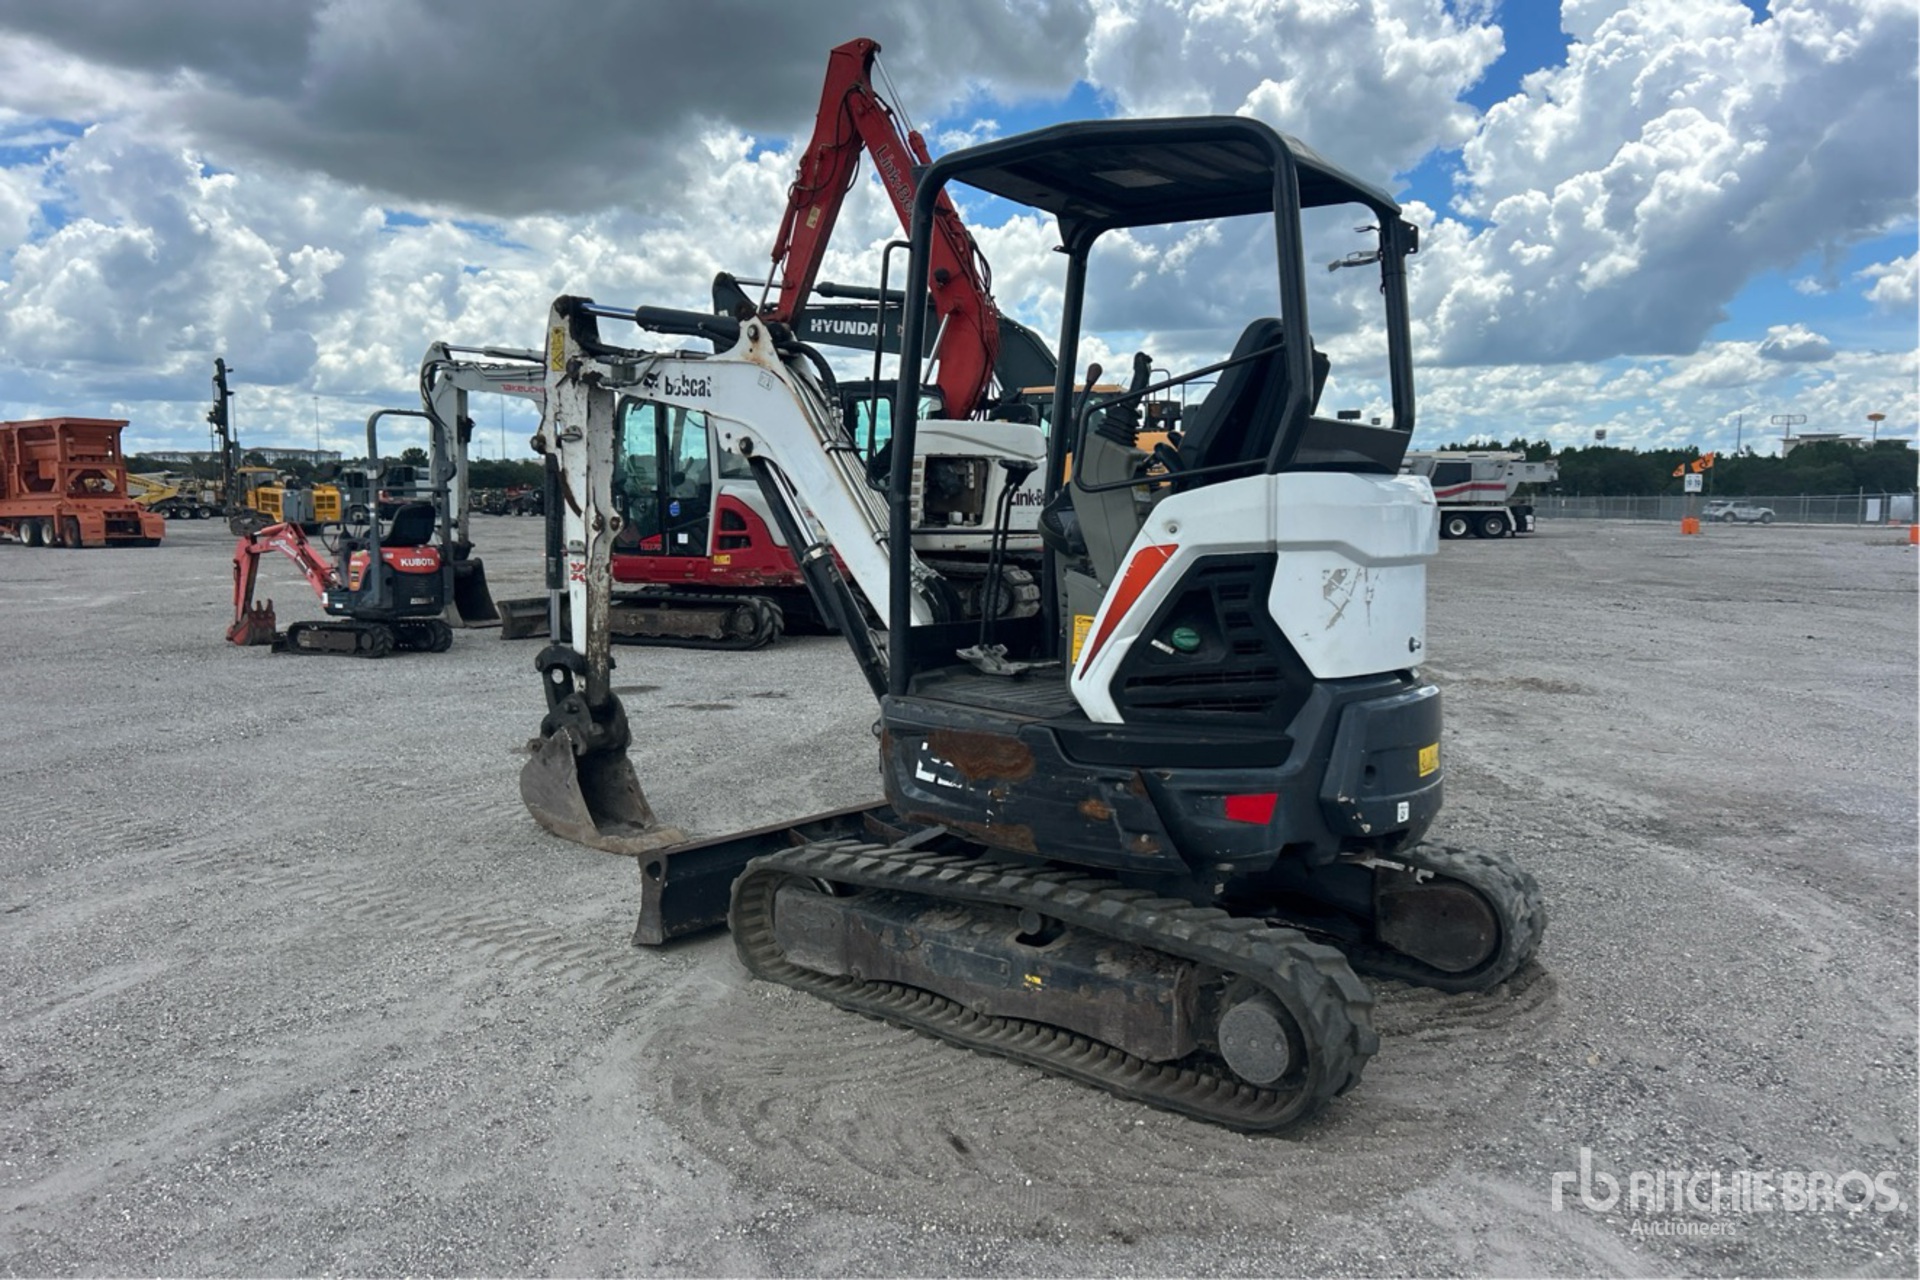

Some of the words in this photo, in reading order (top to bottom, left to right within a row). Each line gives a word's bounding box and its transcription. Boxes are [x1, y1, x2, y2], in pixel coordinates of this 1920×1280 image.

[876, 144, 913, 218] Link-Be
[501, 383, 545, 393] TAKEUCH
[400, 558, 435, 566] KUBOTA
